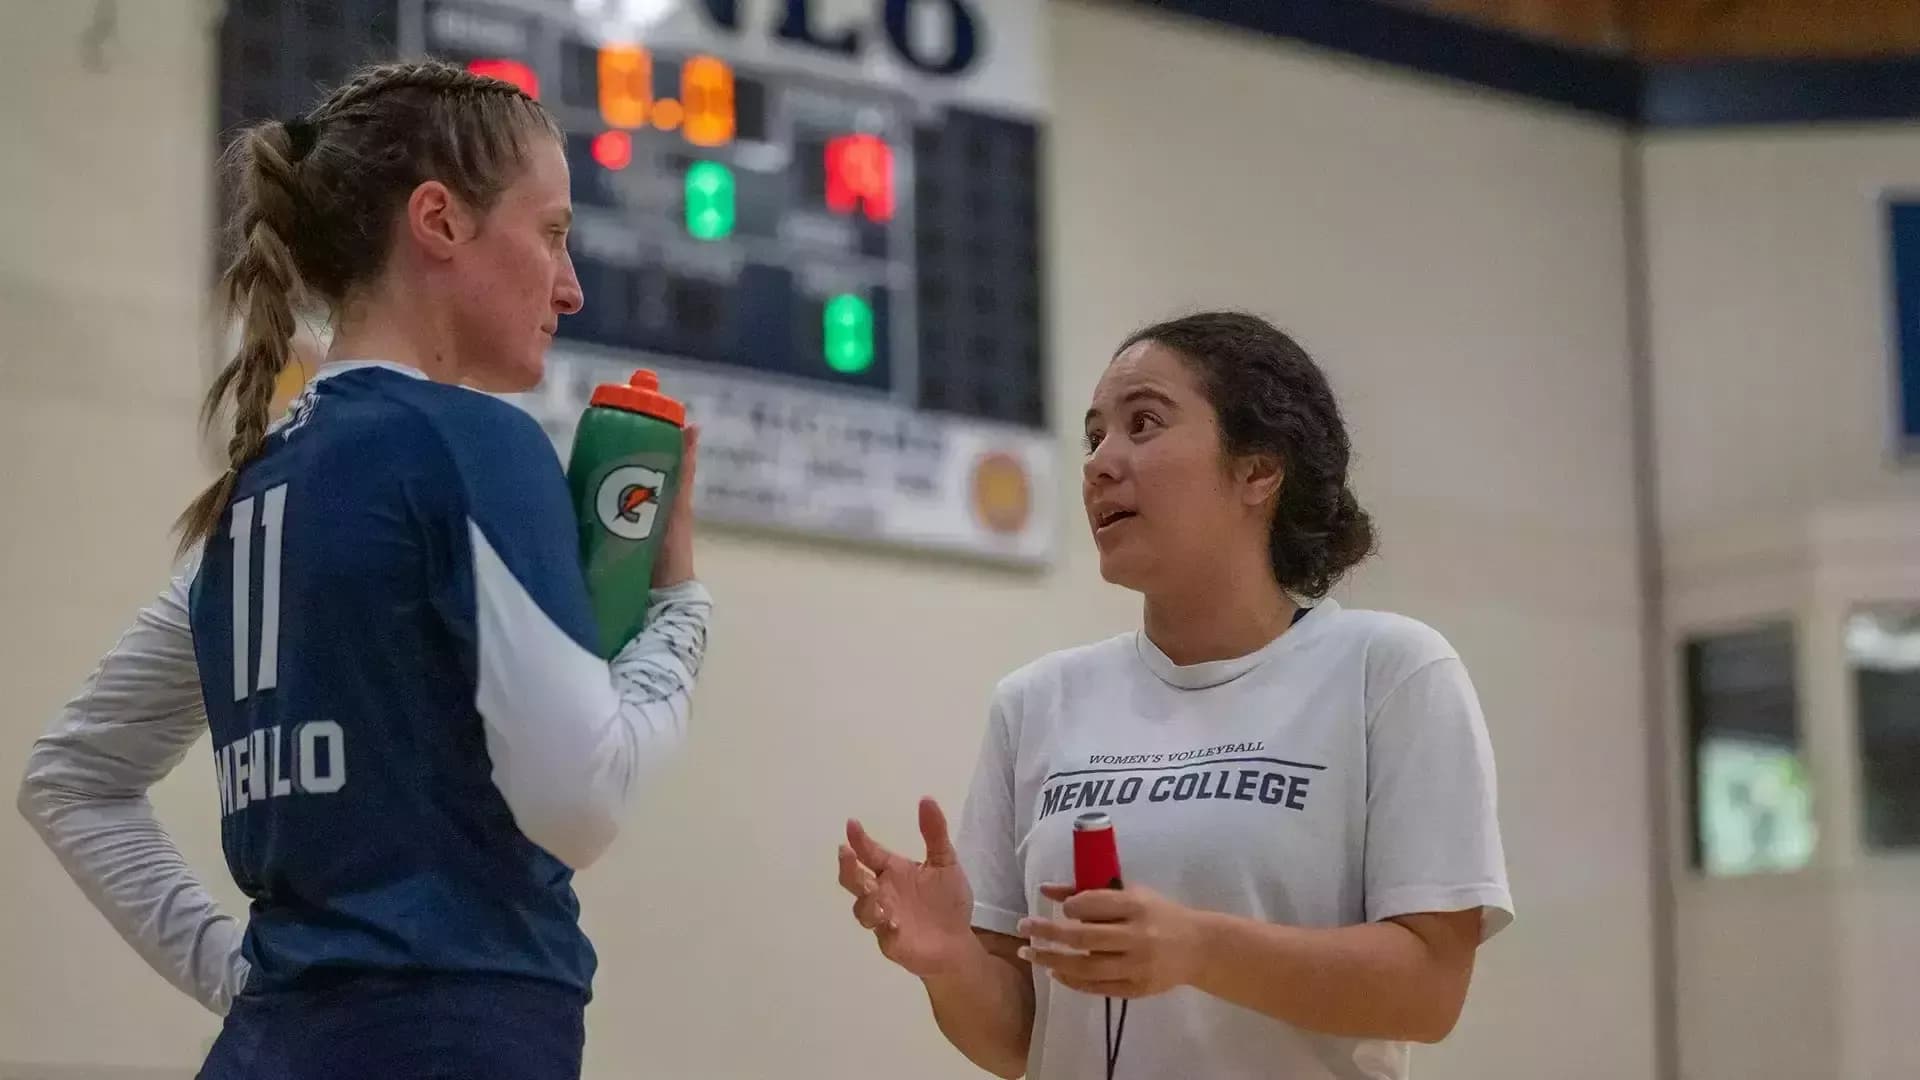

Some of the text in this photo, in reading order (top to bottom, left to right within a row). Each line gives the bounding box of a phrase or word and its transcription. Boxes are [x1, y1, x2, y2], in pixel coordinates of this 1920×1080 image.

[596, 464, 667, 540] G
[230, 483, 288, 702] 11
[214, 720, 347, 818] MENLO
[1088, 741, 1265, 765] WOMEN'S VOLLEYBALL
[1039, 769, 1311, 821] MENLO COLLEGE
